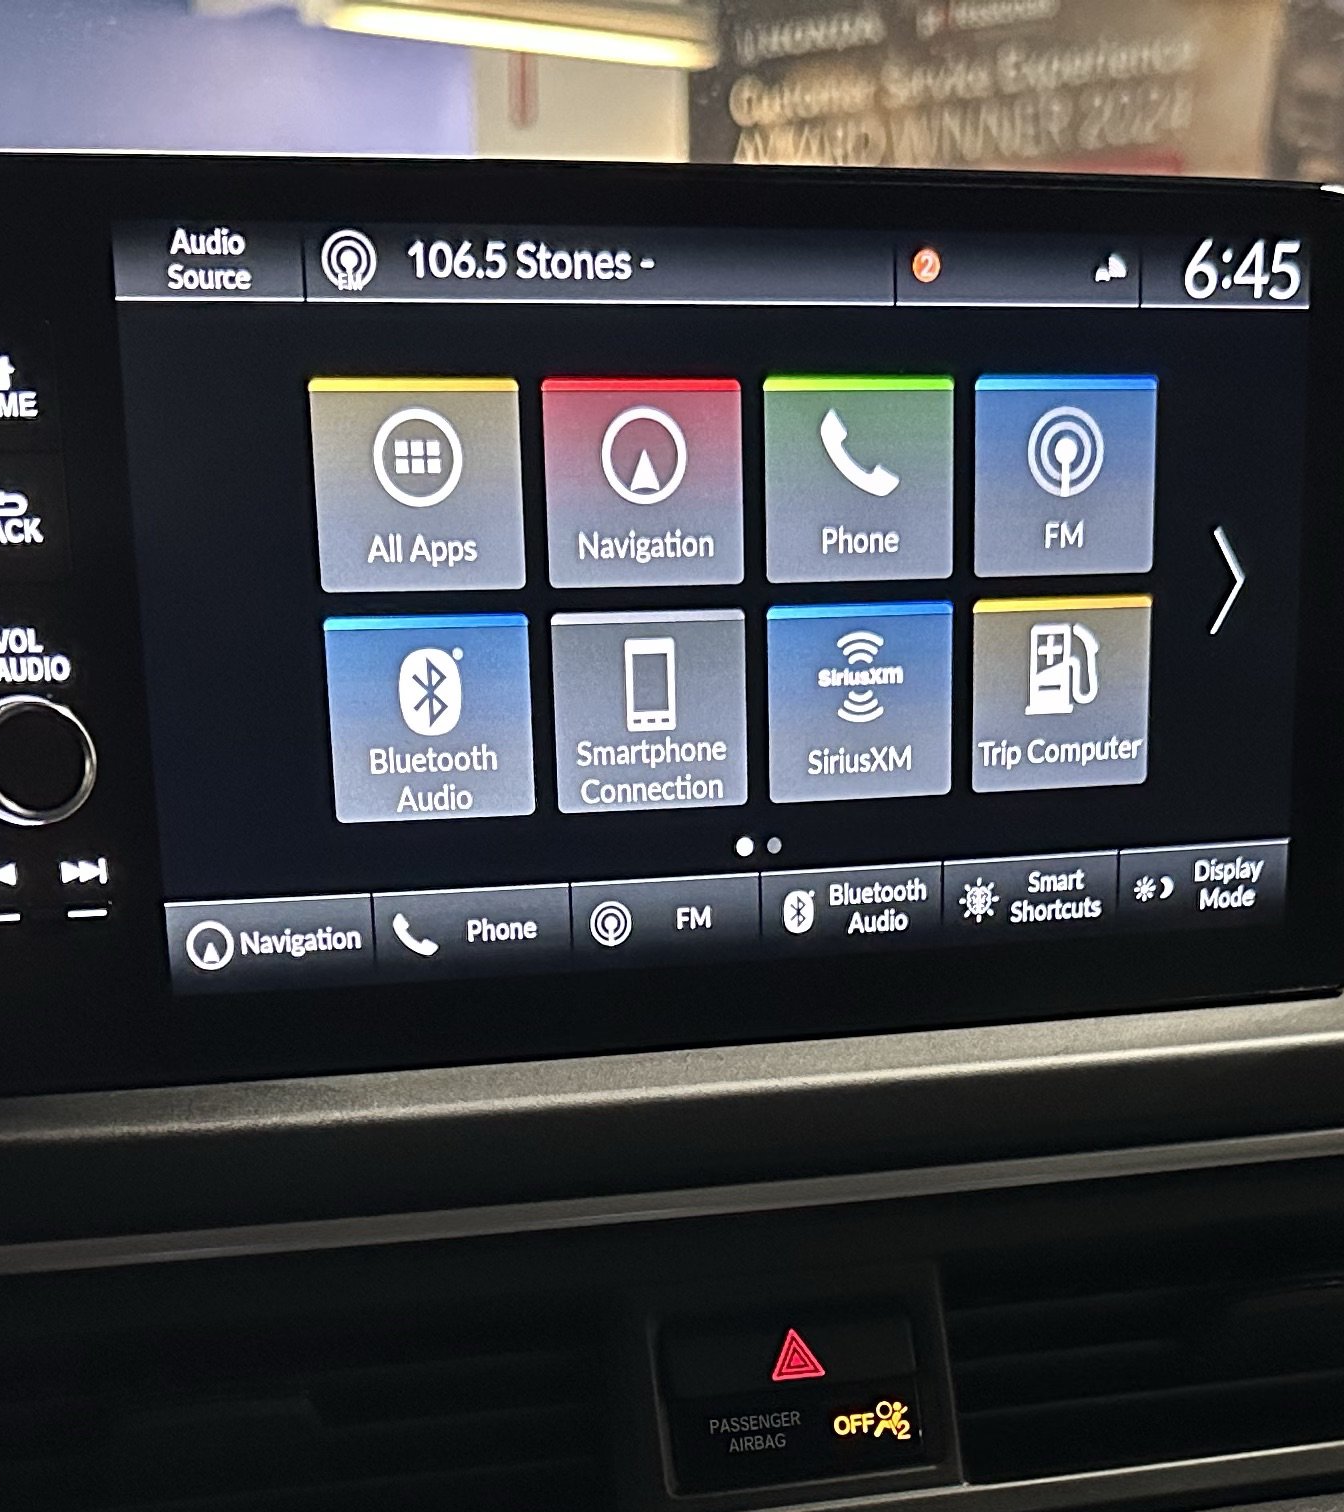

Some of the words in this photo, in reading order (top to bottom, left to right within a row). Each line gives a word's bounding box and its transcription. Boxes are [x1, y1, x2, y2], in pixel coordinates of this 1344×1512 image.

[169, 227, 246, 256] Audio
[407, 239, 508, 279] 106.5
[515, 240, 633, 280] Stones
[1184, 238, 1301, 300] 6:45
[167, 263, 252, 290] Source
[578, 528, 715, 564] Navigation
[822, 524, 900, 555] Phone
[1044, 519, 1084, 549] FM
[367, 532, 403, 564] All
[409, 533, 478, 568] Apps
[369, 743, 498, 775] Bluetooth
[574, 735, 728, 773] Smartphone
[807, 744, 912, 775] SiriusXM
[976, 738, 1023, 773] Trip
[1026, 734, 1144, 770] Computer
[395, 784, 474, 814] Audio
[580, 774, 725, 806] Connection
[1027, 868, 1085, 893] Smart
[1194, 856, 1265, 888] Display
[828, 876, 928, 907] Bluetooth
[1199, 884, 1256, 911] Mode
[676, 904, 712, 930] FM
[847, 907, 909, 935] Audio
[1009, 896, 1102, 923] Shortcuts
[239, 925, 362, 958] Navigation
[467, 917, 538, 943] Phone
[708, 1410, 802, 1435] PASSENGER
[833, 1412, 874, 1436] OFF
[728, 1432, 787, 1454] AIRBAG
